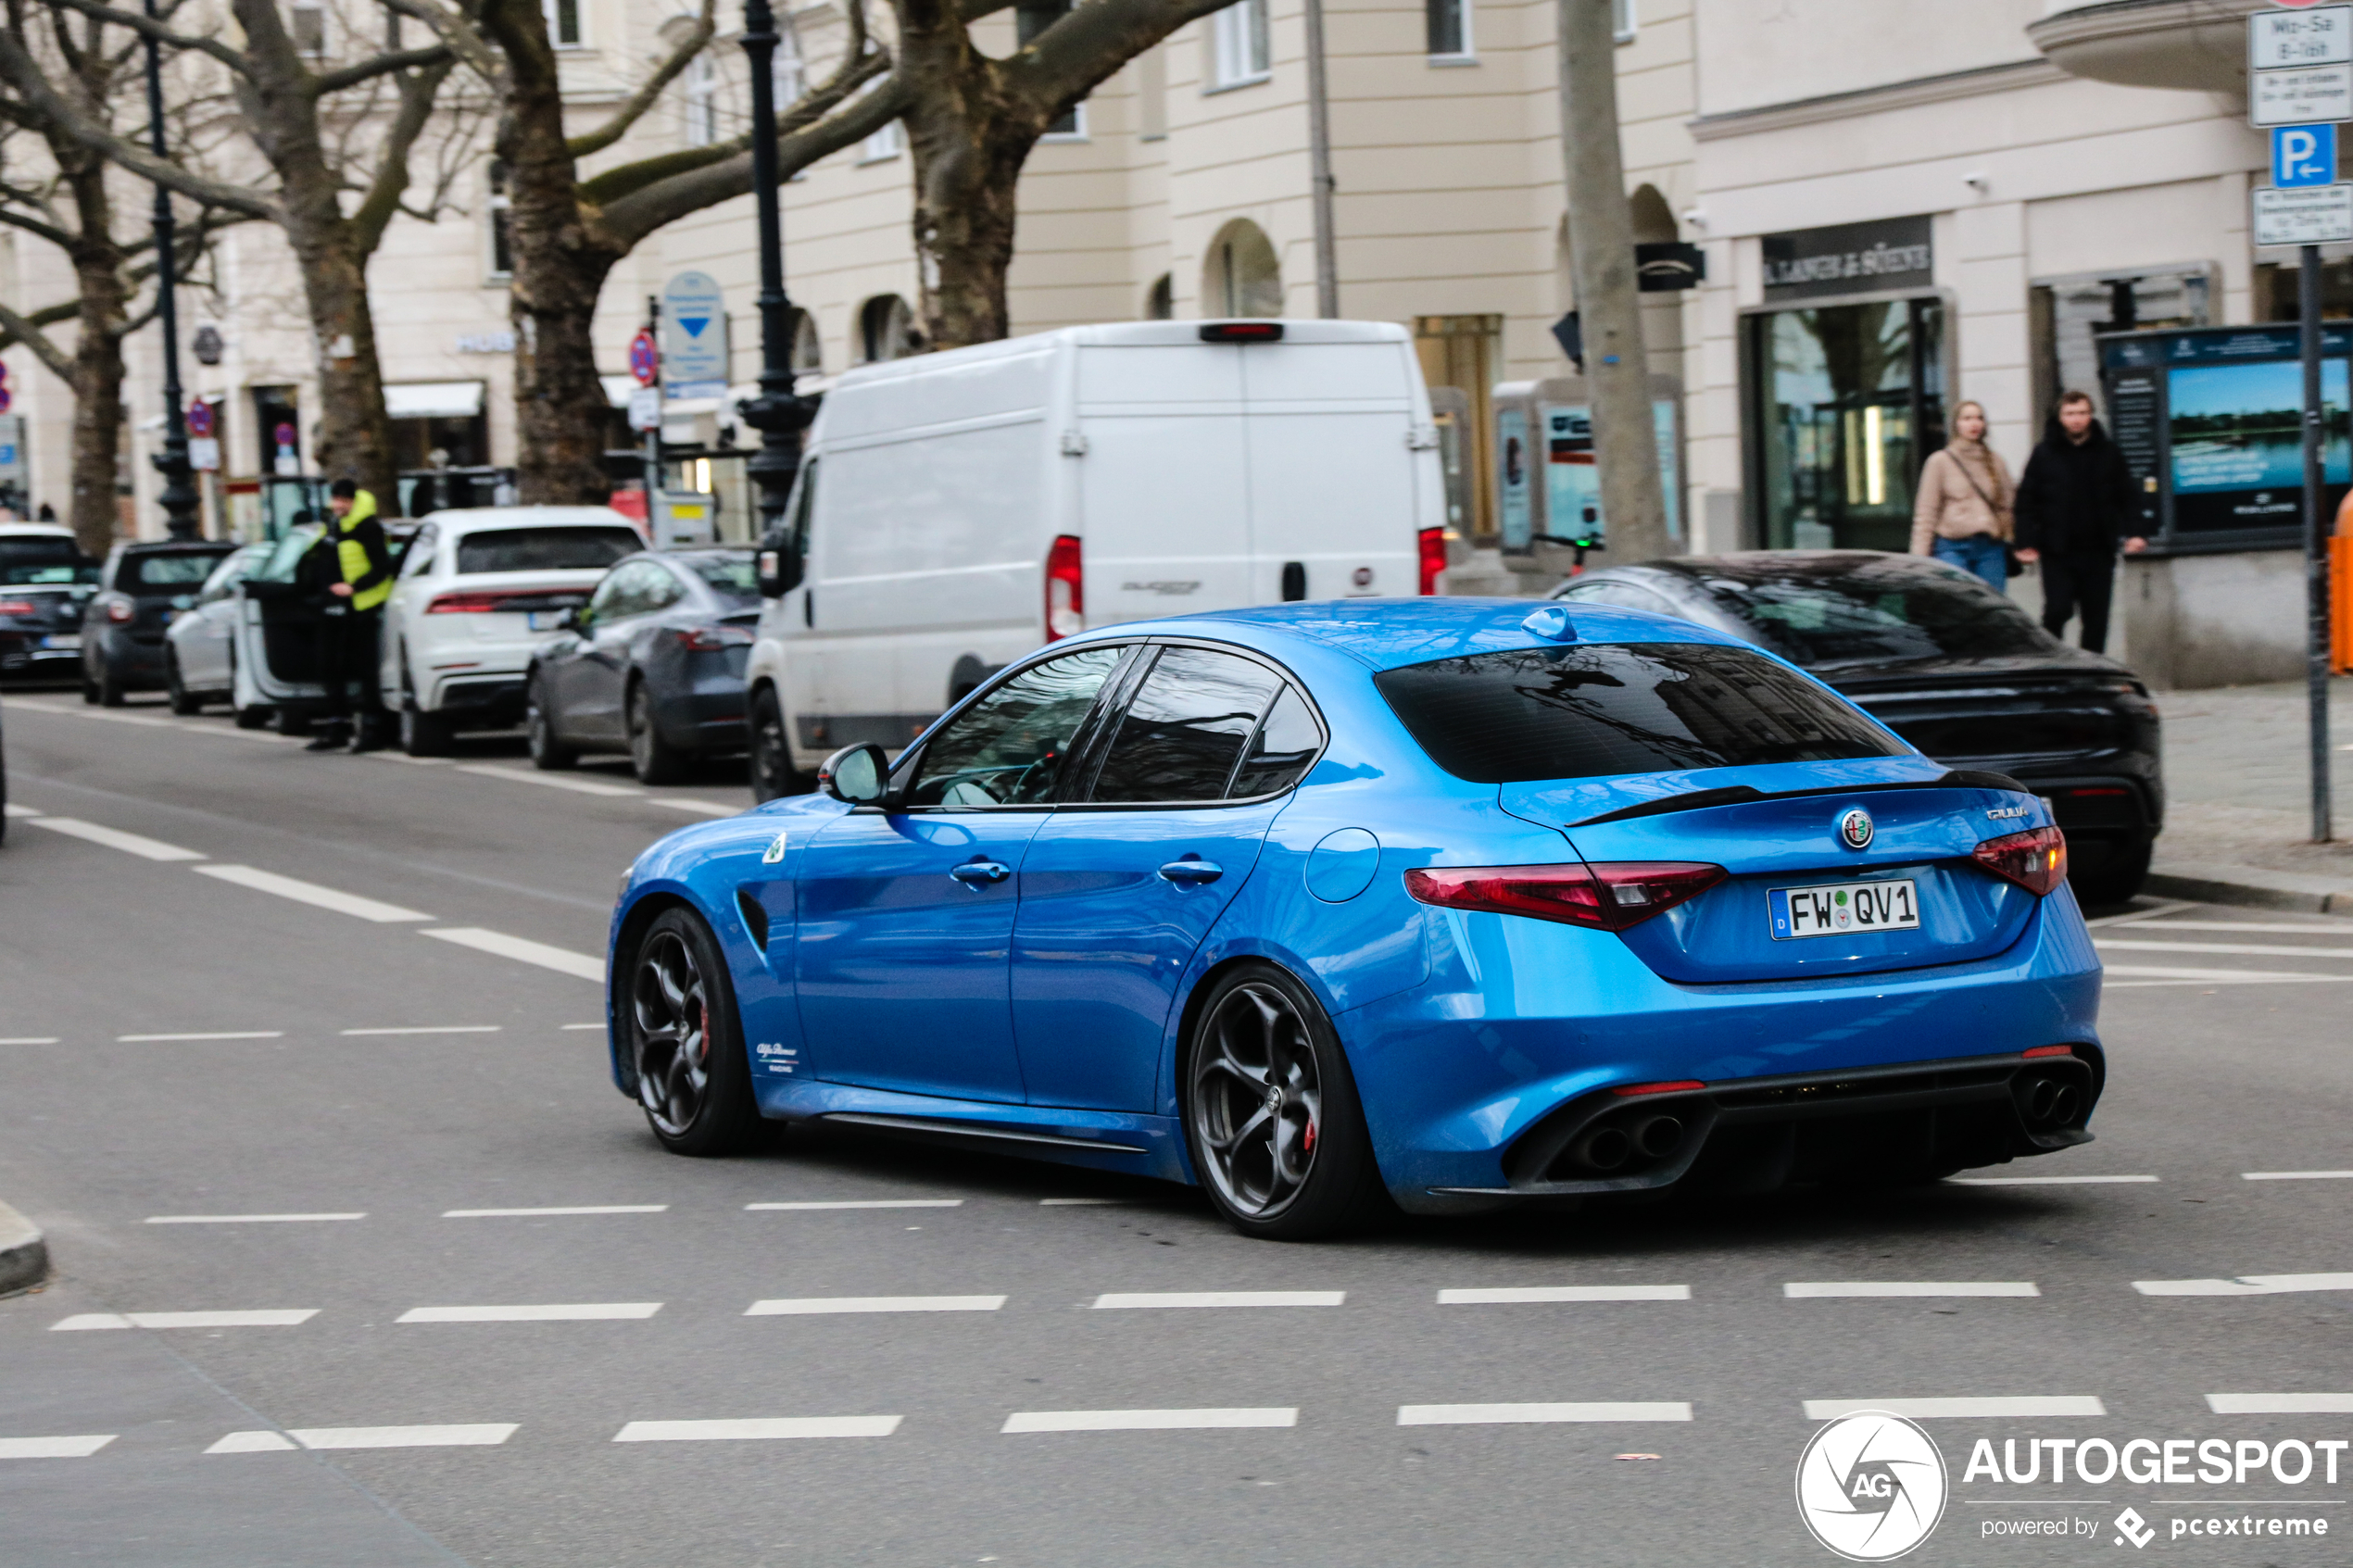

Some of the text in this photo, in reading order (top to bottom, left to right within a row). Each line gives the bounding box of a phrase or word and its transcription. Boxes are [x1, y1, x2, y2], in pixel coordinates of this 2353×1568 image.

[2282, 131, 2317, 180] P
[1987, 807, 2029, 820] GIULIA
[1791, 885, 1915, 931] FW QV1
[1777, 919, 1785, 930] D
